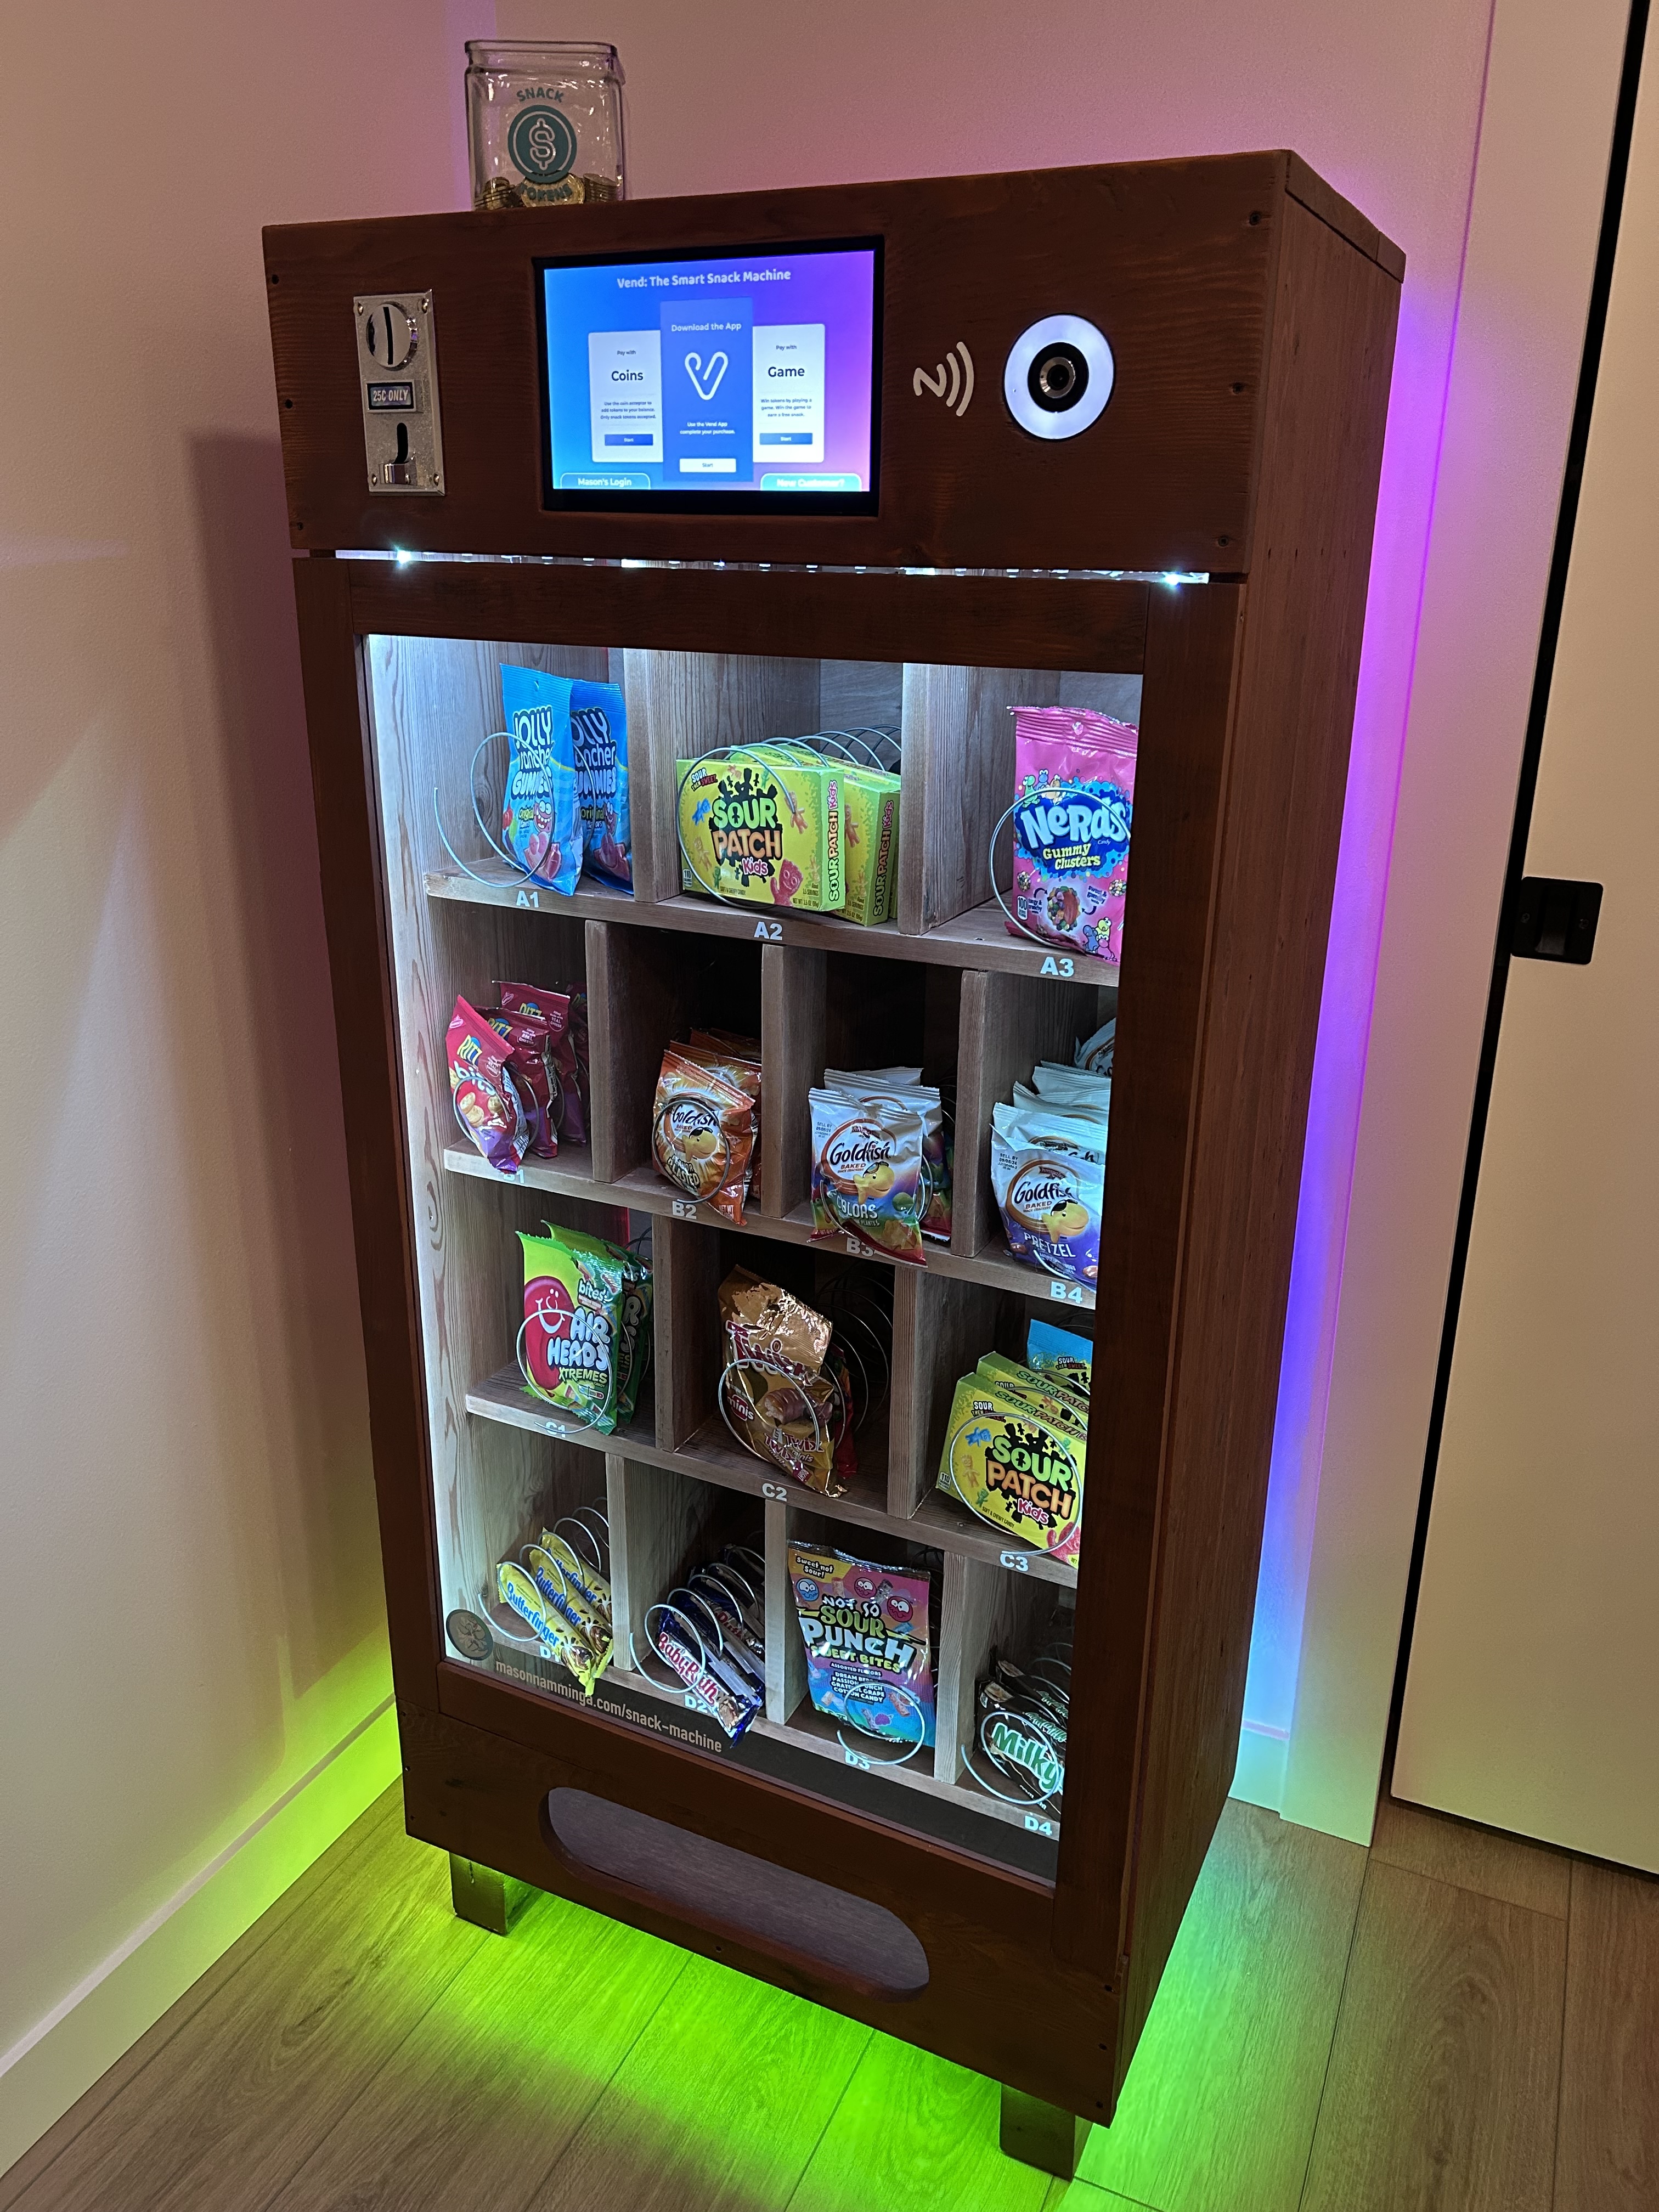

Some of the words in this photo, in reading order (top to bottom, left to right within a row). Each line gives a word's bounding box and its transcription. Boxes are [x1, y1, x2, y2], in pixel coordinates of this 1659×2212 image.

[516, 87, 564, 103] SNACK
[617, 276, 648, 289] Vend:
[649, 276, 669, 286] The
[672, 274, 705, 286] Smart
[707, 272, 741, 284] Snack
[742, 269, 791, 282] Machine
[671, 323, 709, 332] Download
[725, 322, 742, 331] App
[611, 369, 644, 381] Coins
[768, 366, 805, 377] Game
[388, 390, 409, 402] ONLY
[578, 477, 610, 487] Mason's
[612, 477, 632, 488] Login
[515, 711, 551, 749] JOLLY
[571, 712, 609, 747] OLLY
[575, 743, 616, 767] ancher
[576, 766, 617, 795] UMMIES
[691, 768, 707, 783] SOUR
[827, 780, 838, 810] Kids
[713, 797, 777, 830] SOUR
[882, 799, 894, 829] Kids
[713, 830, 782, 860] PATCH
[828, 810, 839, 859] PATCH
[877, 829, 891, 876] PATCH
[1043, 843, 1092, 860] Gummy
[742, 856, 769, 877] Kids
[1054, 855, 1102, 870] Clusters
[684, 870, 692, 879] 110
[828, 858, 840, 902] SOUR
[516, 890, 540, 909] A1
[873, 875, 887, 917] SOUR
[1018, 896, 1028, 911] 100
[754, 921, 783, 941] A2
[1040, 957, 1075, 977] A3
[456, 1034, 483, 1065] RITZ
[830, 1141, 891, 1166] Goldfish
[672, 1200, 697, 1220] B2
[837, 1195, 878, 1219] COLORS
[1025, 1200, 1053, 1209] BAKED
[1023, 1232, 1076, 1258] PRETZEL
[1051, 1281, 1083, 1304] B4
[570, 1307, 611, 1344] AIR
[547, 1336, 610, 1372] HEADS
[558, 1367, 608, 1385] XTREMES
[1017, 1370, 1057, 1395] SOUR
[1056, 1391, 1089, 1414] PATC
[727, 1396, 755, 1421] minis
[974, 1401, 994, 1410] SOUR
[995, 1390, 1035, 1414] SOUR
[1034, 1411, 1080, 1435] PATCH
[545, 1421, 566, 1438] C1
[763, 1432, 798, 1462] Twix
[783, 1433, 825, 1452] Twix
[992, 1434, 1073, 1493] SOUR
[941, 1473, 950, 1483] 110
[762, 1482, 787, 1502] C2
[986, 1458, 1073, 1520] PATCH
[992, 1513, 1005, 1522] CHEWY
[1003, 1518, 1015, 1528] CANDY
[1018, 1498, 1050, 1525] Kids
[797, 1556, 819, 1568] Sweet
[804, 1566, 825, 1578] Sour!
[1000, 1553, 1029, 1572] C3
[506, 1582, 560, 1648] Butterfinger
[822, 1596, 856, 1610] NOT
[862, 1602, 880, 1617] SO
[820, 1606, 884, 1639] SOUR
[798, 1615, 916, 1664] PUNCH
[658, 1631, 690, 1675] Baby
[859, 1654, 901, 1673] BITES
[831, 1662, 857, 1672] ASSORTED
[834, 1672, 857, 1681] DREAM
[832, 1676, 859, 1686] PASSION
[863, 1684, 883, 1692] UNCH
[863, 1688, 885, 1697] GRAPE
[495, 1658, 723, 1754] masonnamminga.com/snack-machine
[685, 1694, 708, 1714] D2
[860, 1692, 883, 1702] CANDY
[993, 1723, 1059, 1793] Milky
[1024, 1815, 1052, 1836] D4
